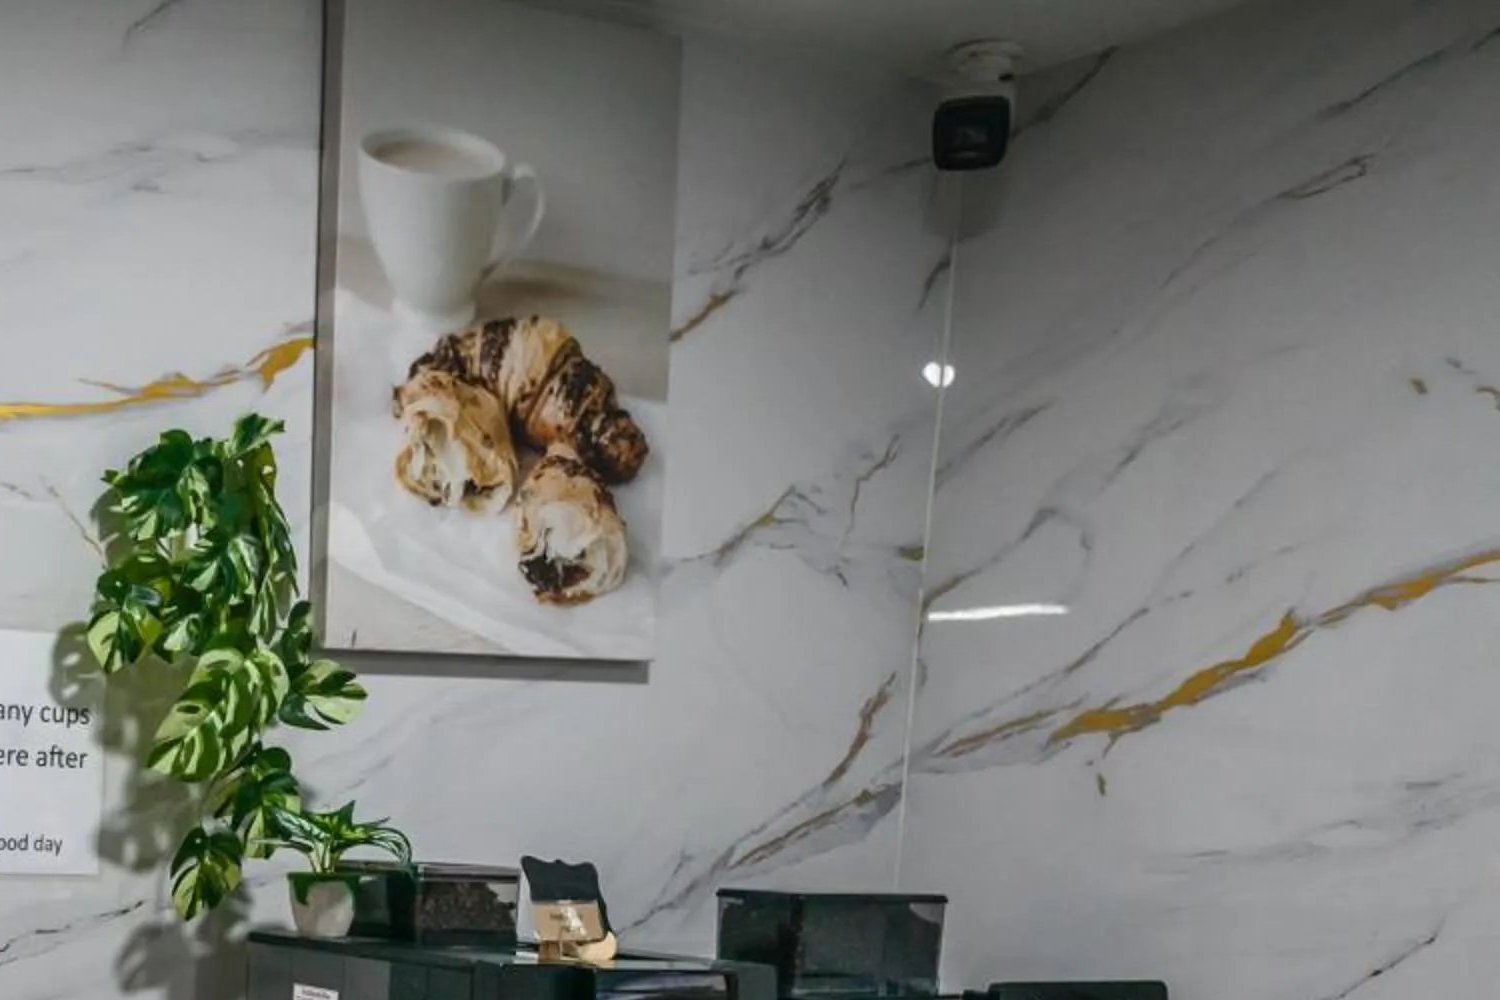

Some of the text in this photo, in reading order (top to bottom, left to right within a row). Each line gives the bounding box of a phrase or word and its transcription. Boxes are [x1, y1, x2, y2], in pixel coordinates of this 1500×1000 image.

[40, 704, 91, 728] cups
[36, 743, 88, 768] after
[33, 834, 63, 856] day
